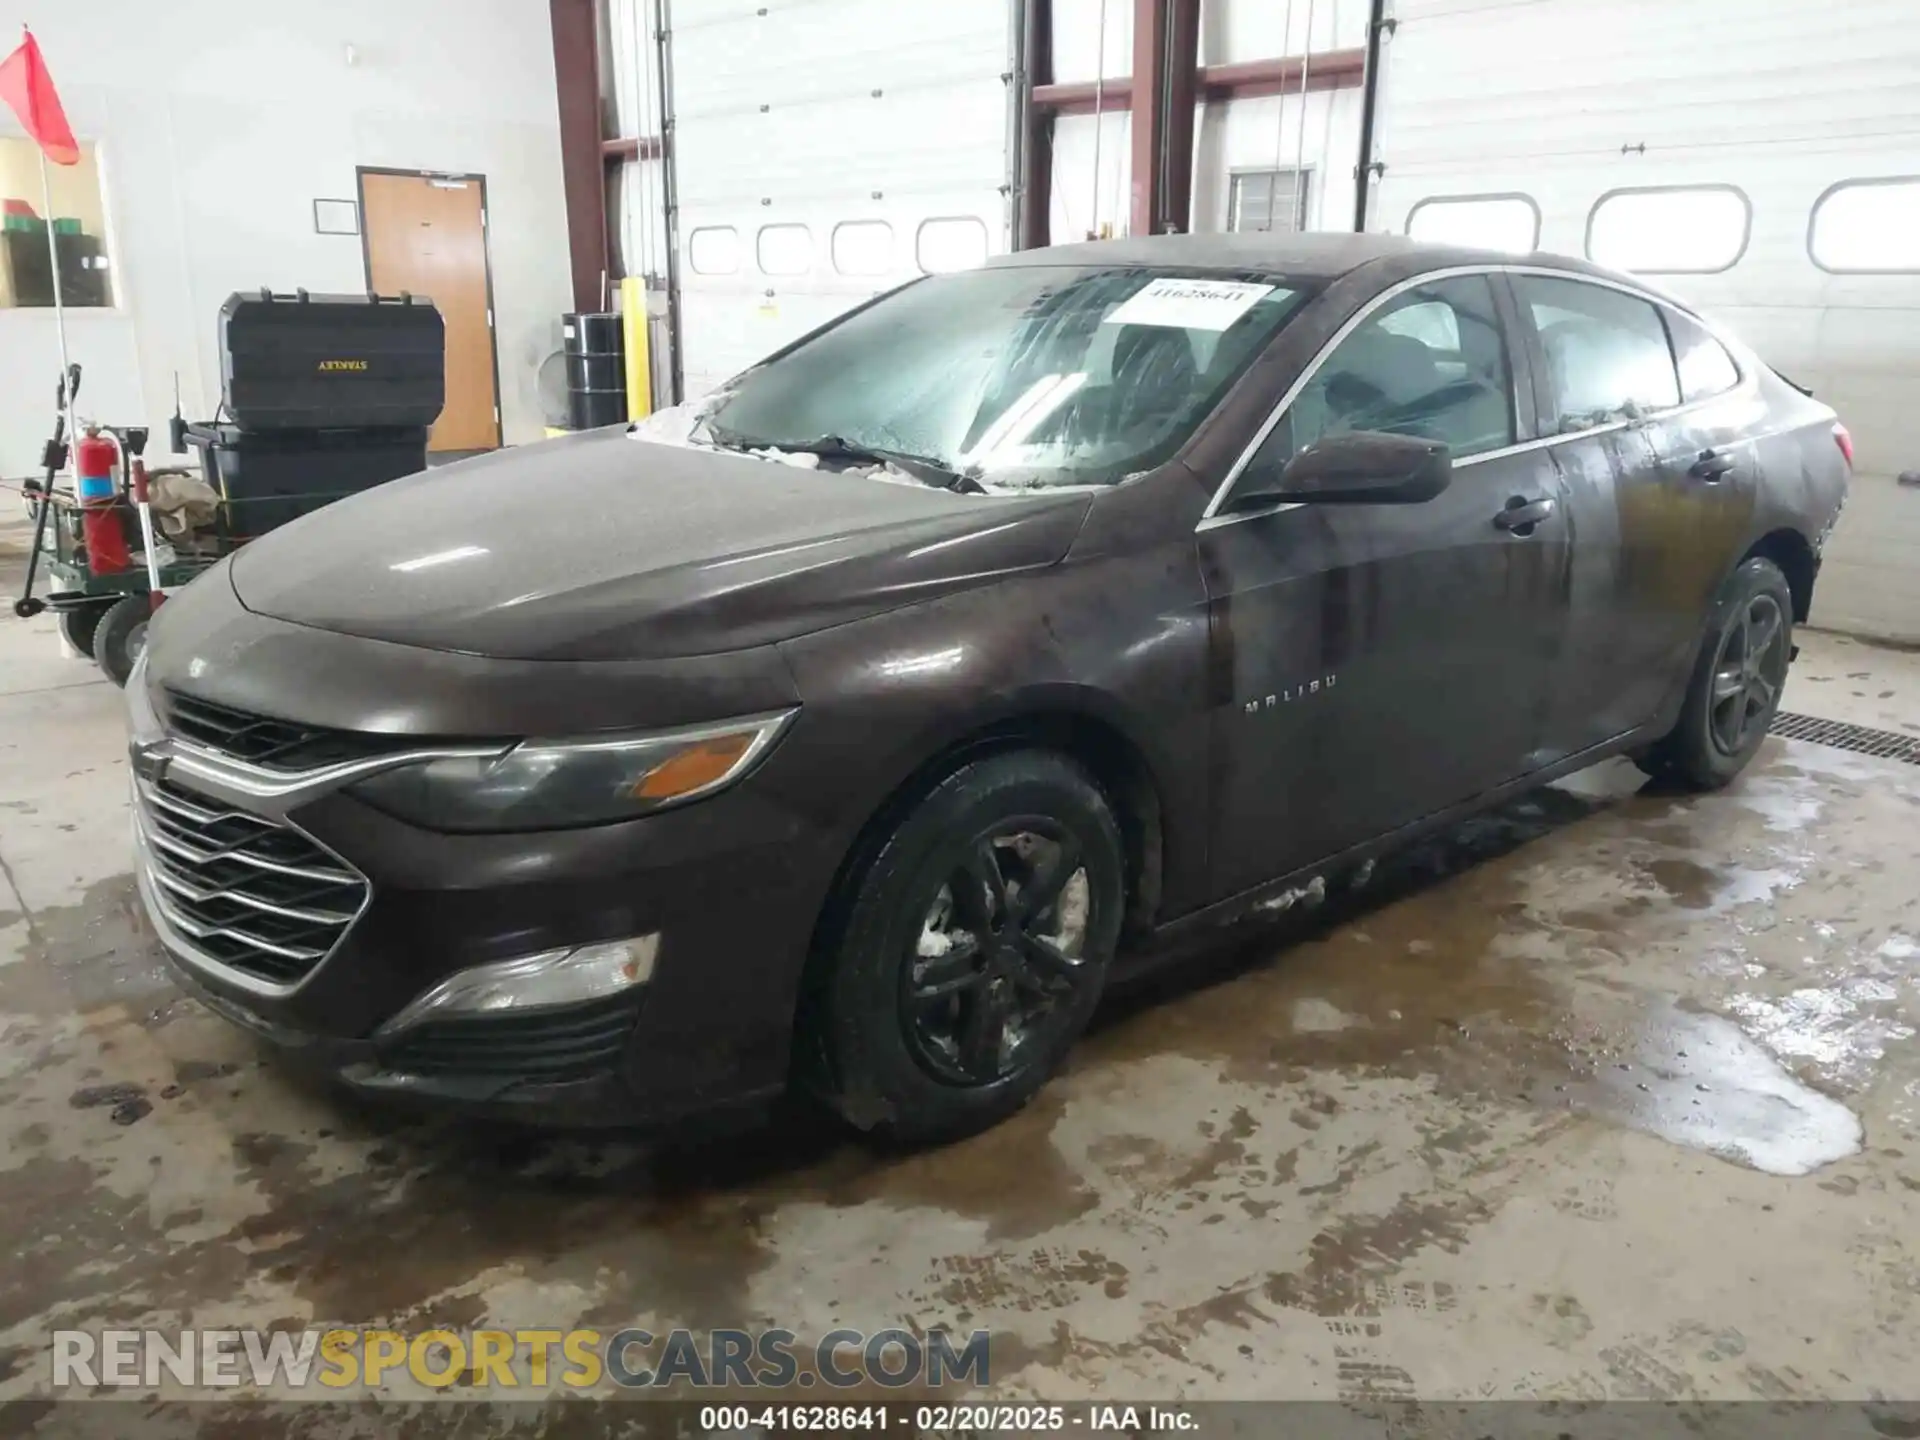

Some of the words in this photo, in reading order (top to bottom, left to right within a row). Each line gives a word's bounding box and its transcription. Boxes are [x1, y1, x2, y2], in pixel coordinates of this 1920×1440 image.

[1151, 288, 1244, 300] 41628641
[318, 360, 368, 370] STANLEY
[1244, 674, 1336, 712] MALIBU
